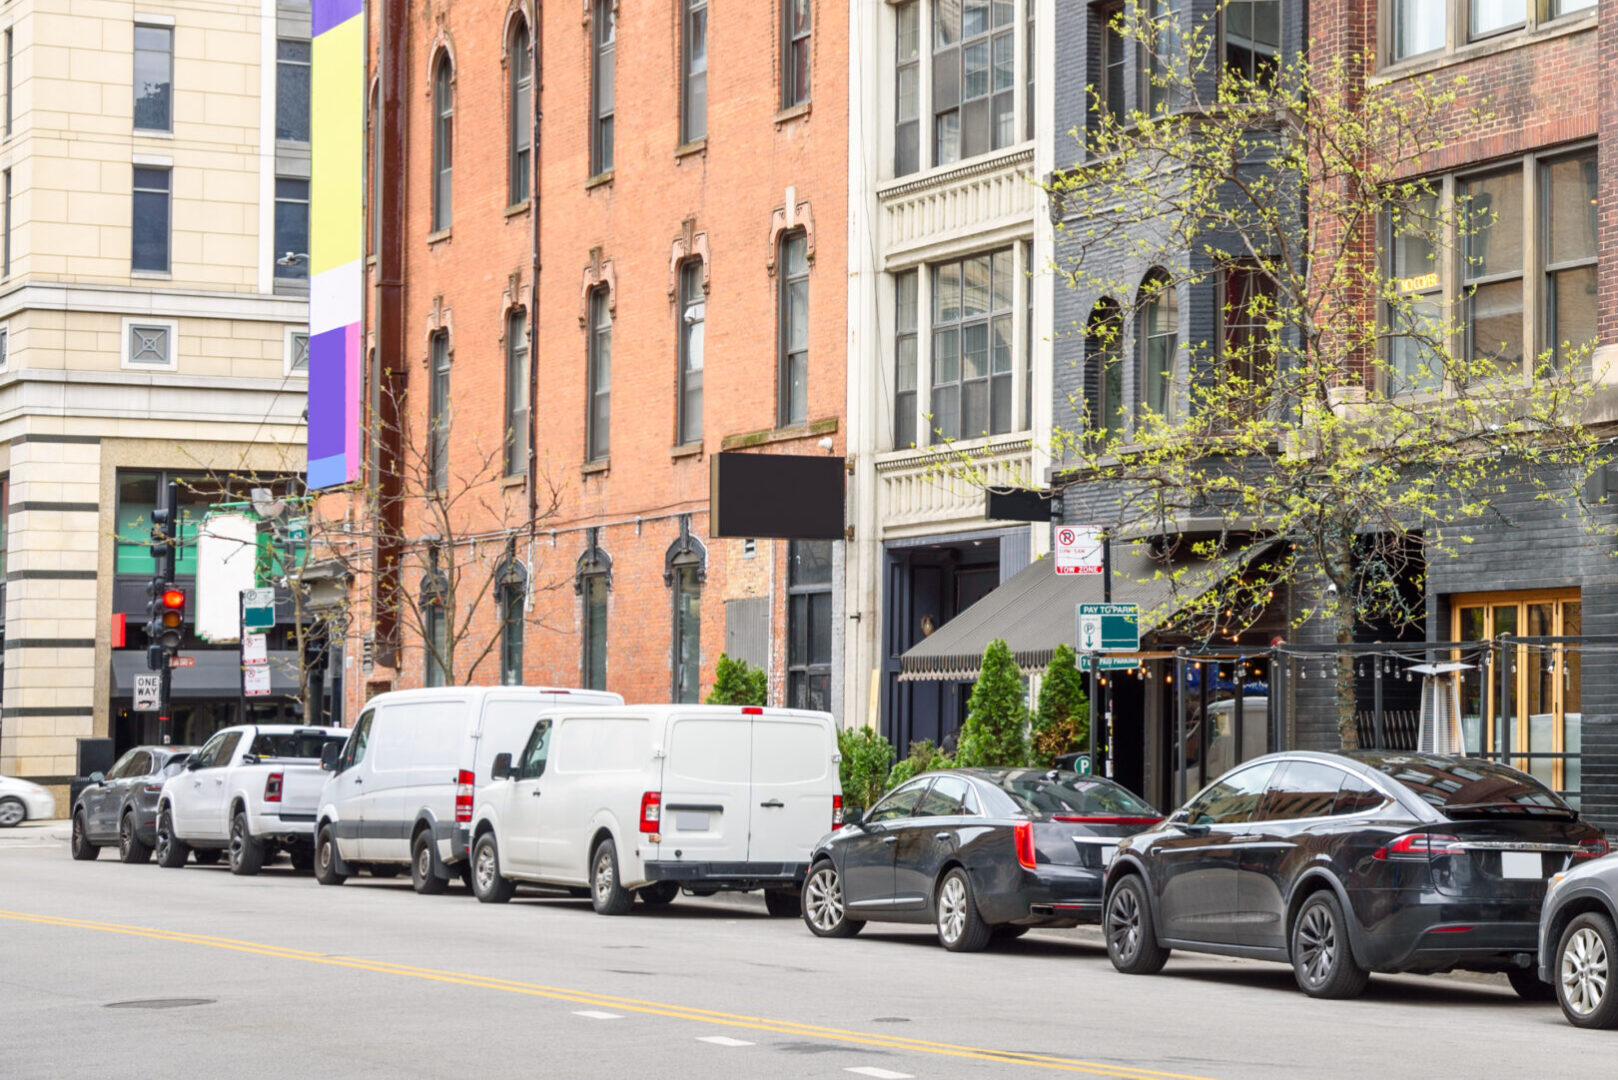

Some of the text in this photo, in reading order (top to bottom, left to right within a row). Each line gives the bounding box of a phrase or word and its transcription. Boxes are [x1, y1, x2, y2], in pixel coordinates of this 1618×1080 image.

[1401, 278, 1413, 291] NO
[1083, 606, 1098, 614] PAY
[1100, 606, 1112, 614] TO
[1086, 624, 1093, 633] P
[138, 677, 157, 686] ONE
[138, 687, 157, 696] WAY
[1080, 759, 1089, 773] P
